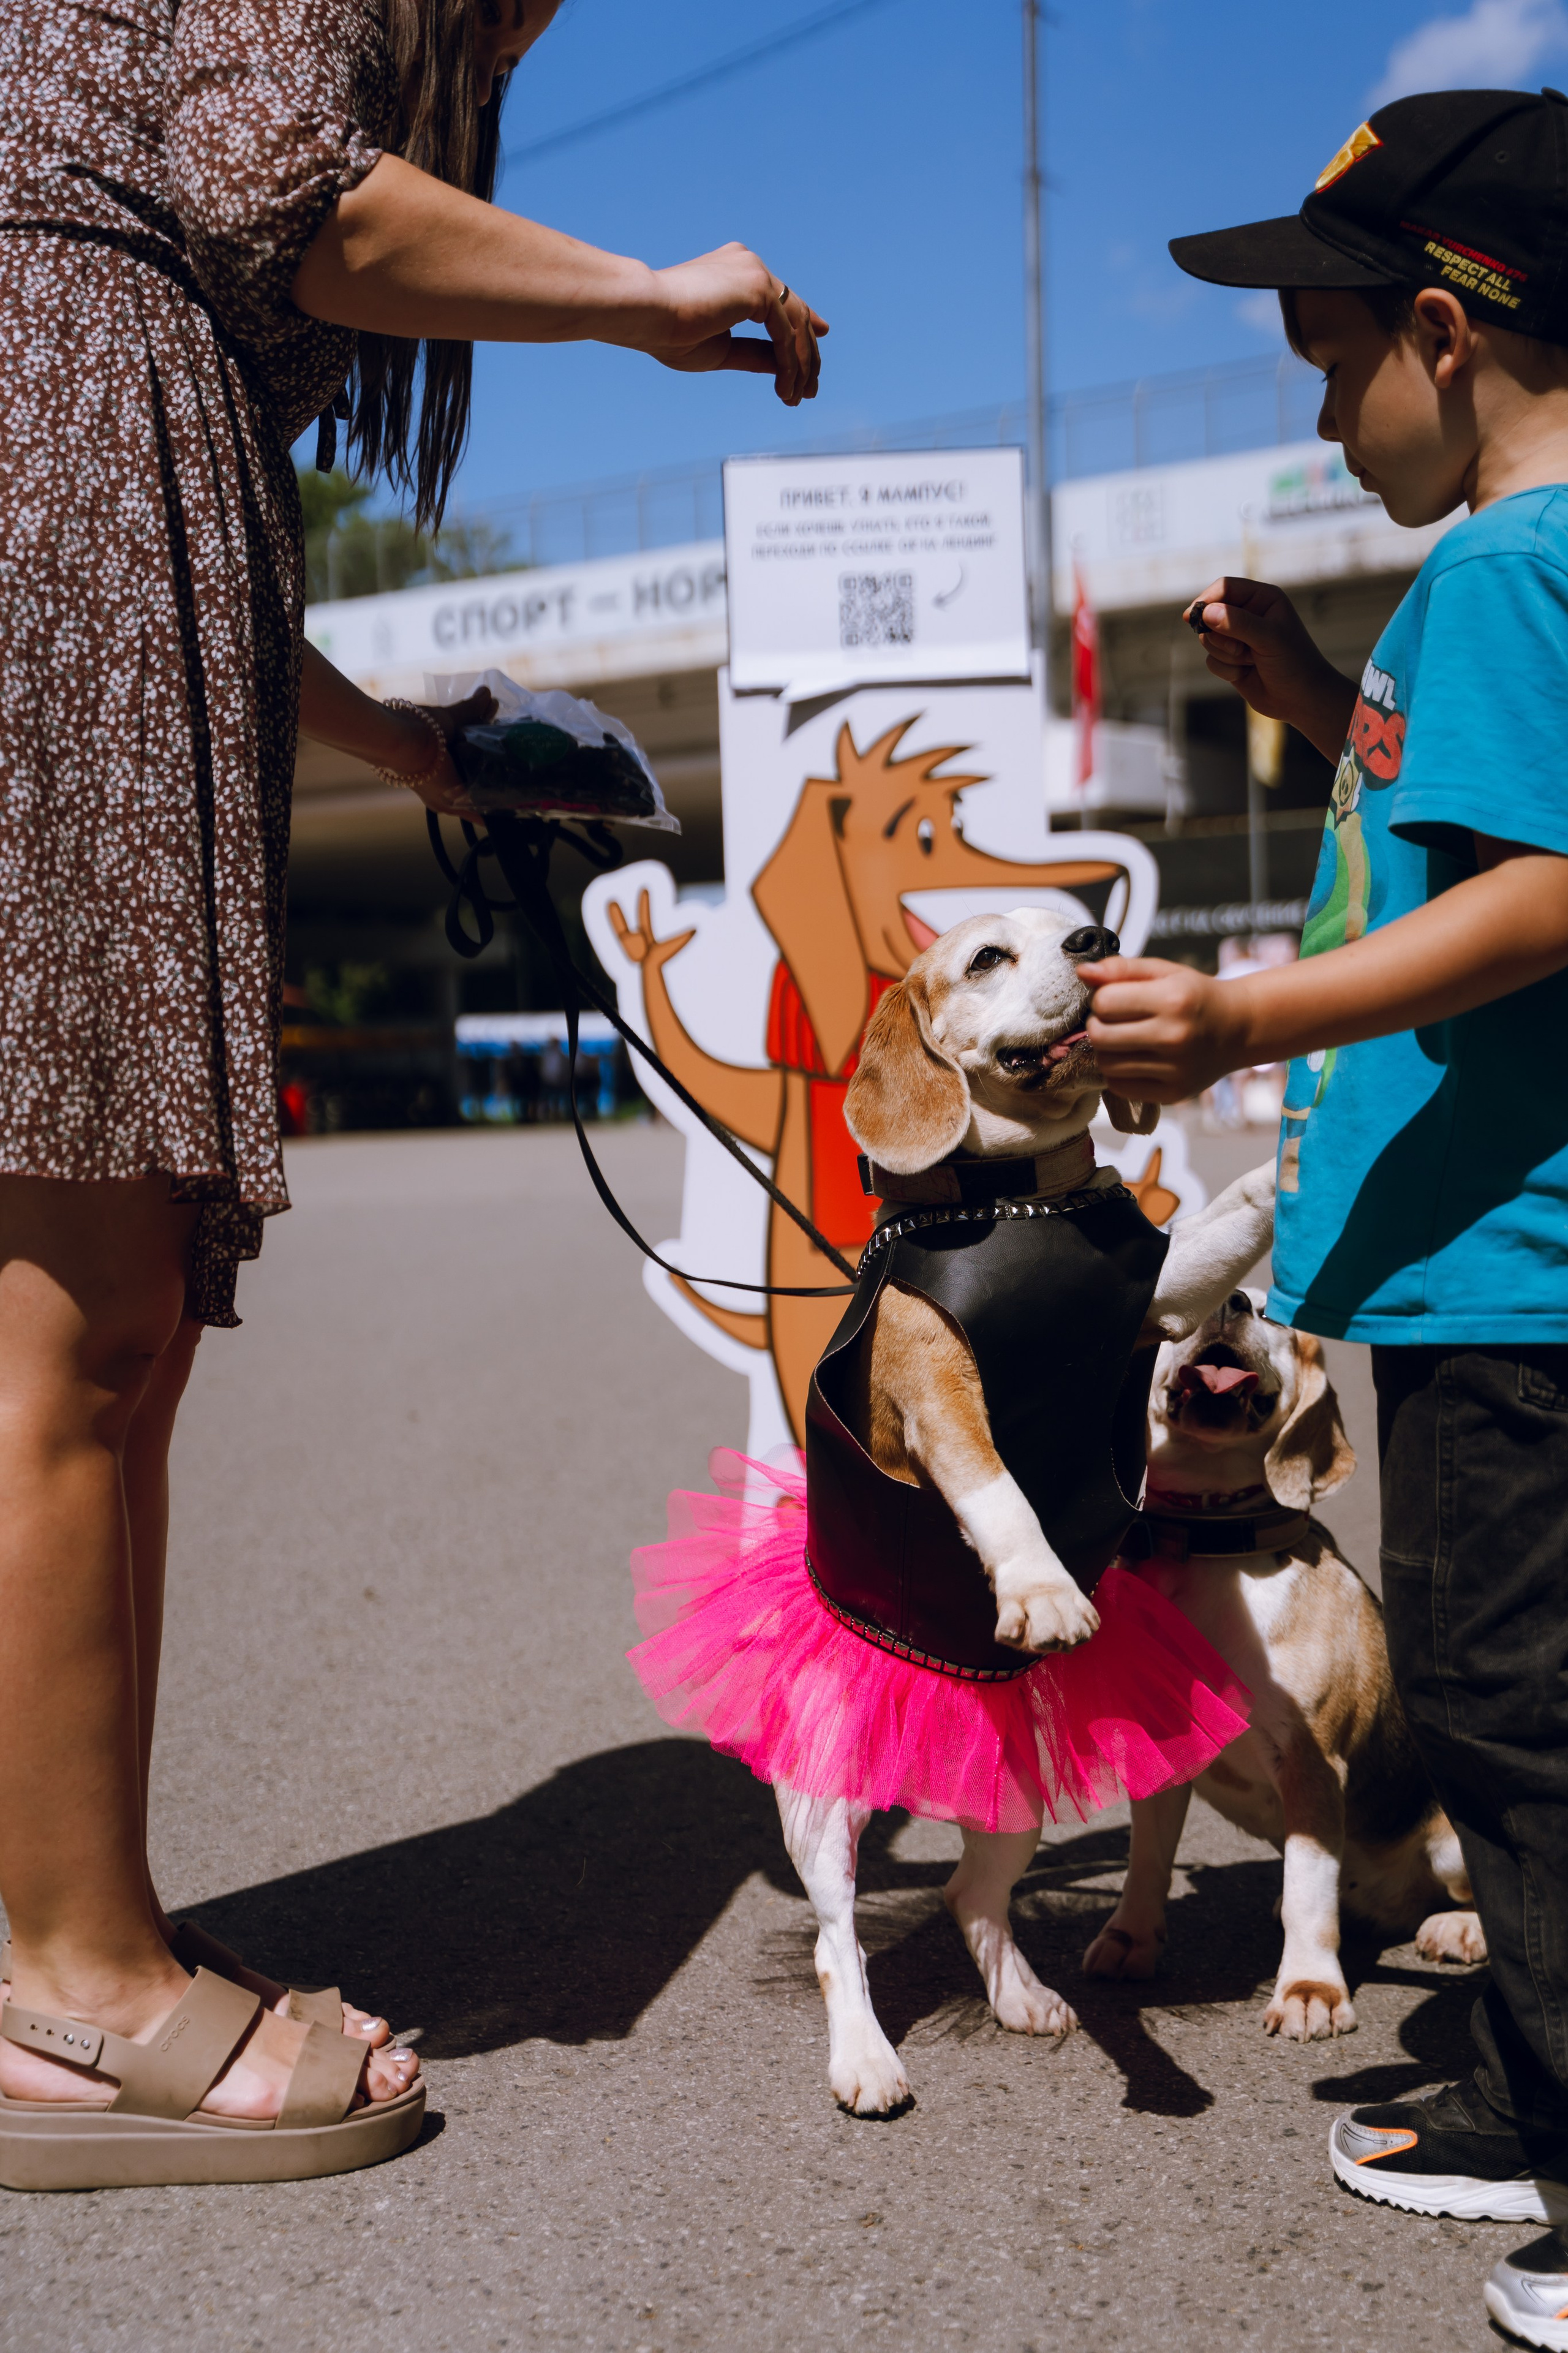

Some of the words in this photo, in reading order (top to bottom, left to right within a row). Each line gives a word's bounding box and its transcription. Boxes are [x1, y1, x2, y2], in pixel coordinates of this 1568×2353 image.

[1425, 241, 1488, 279] RESPECT
[1484, 273, 1511, 291] ALL
[1440, 265, 1478, 290] FEAR
[1477, 282, 1521, 309] NONE
[858, 483, 871, 507] Я
[431, 582, 577, 652] СПОРТ
[1347, 693, 1406, 779] ARS
[160, 2015, 190, 2052] crocs
